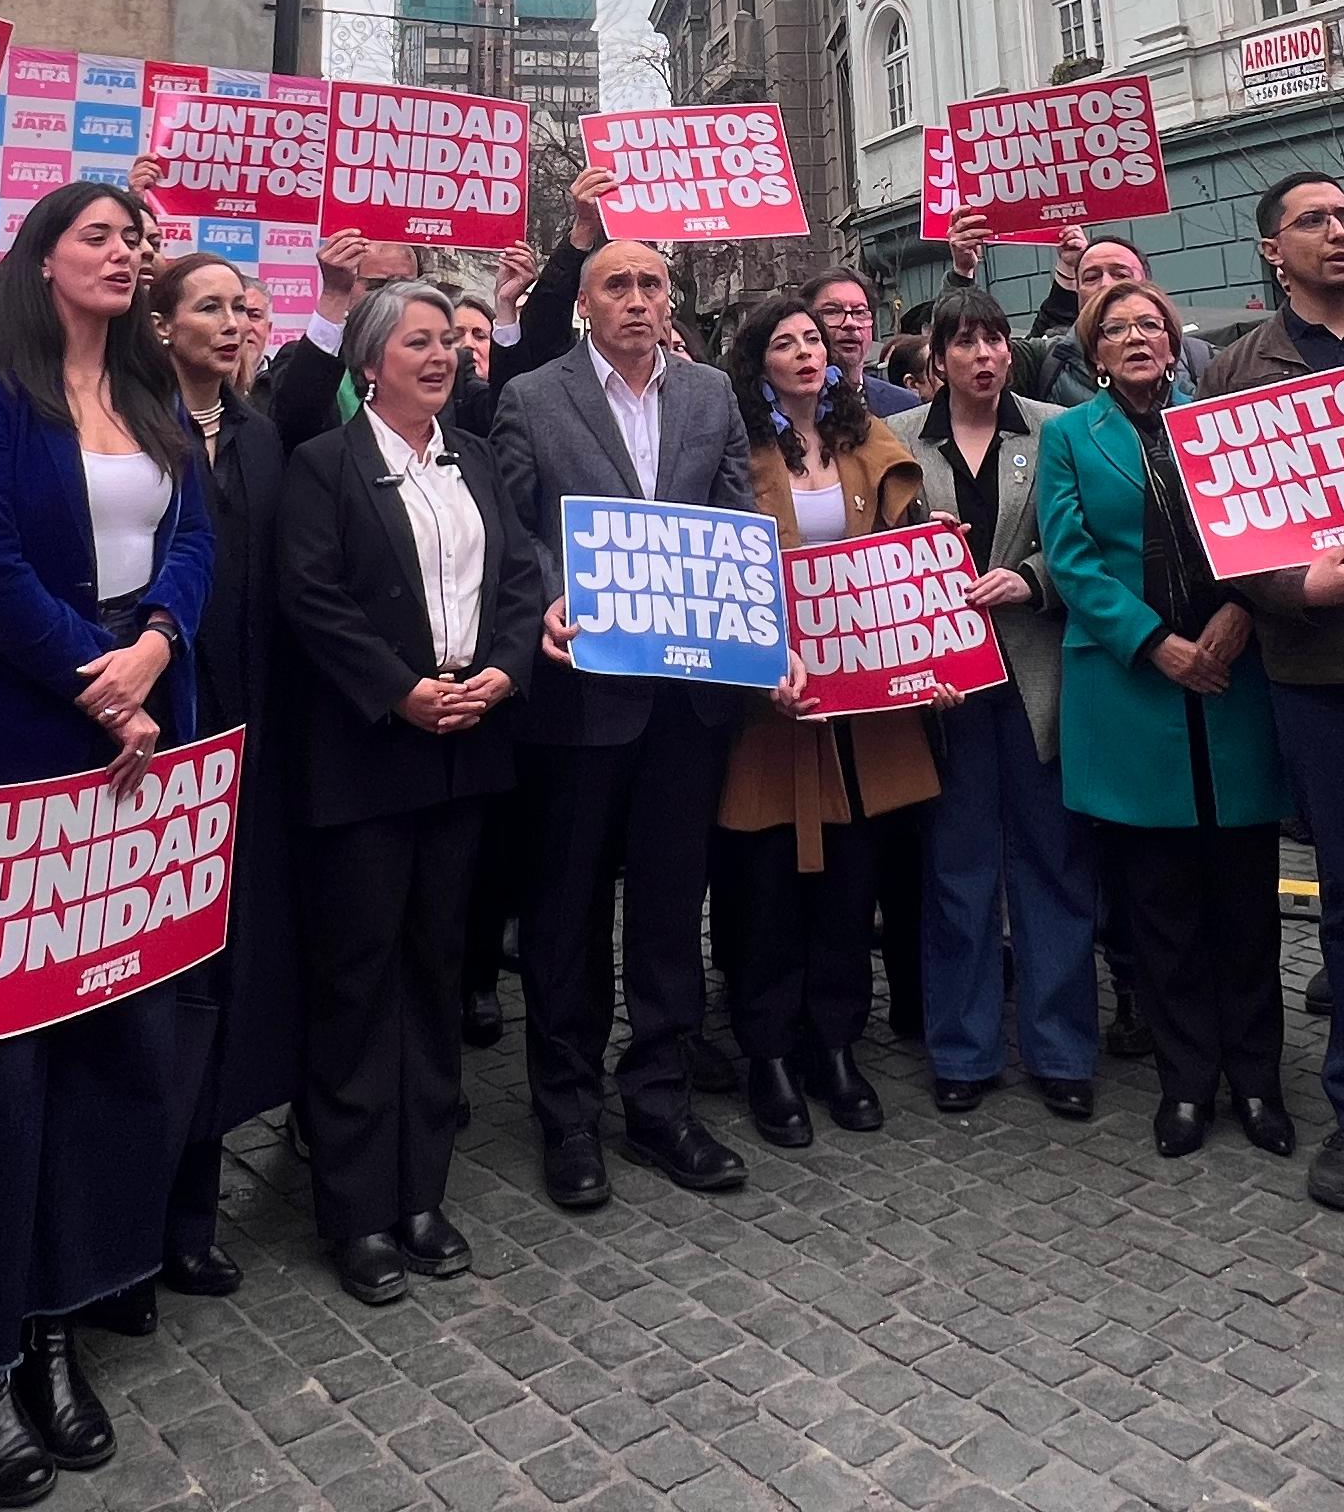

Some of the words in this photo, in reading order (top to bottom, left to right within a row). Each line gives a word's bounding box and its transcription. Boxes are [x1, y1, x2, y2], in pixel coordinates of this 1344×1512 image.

[1245, 28, 1321, 71] ARRIENDO
[15, 67, 71, 83] JARA
[84, 75, 136, 89] JARA
[12, 117, 67, 132] JARA
[80, 122, 133, 138] JARA
[159, 102, 328, 140] JUNTOS
[339, 92, 523, 143] UNIDAD
[593, 113, 777, 151] JUNTOS
[957, 86, 1145, 141] JUNTOS
[156, 131, 325, 169] JUNTOS
[336, 129, 522, 179] UNIDAD
[611, 144, 785, 183] JUNTOS
[961, 120, 1151, 174] JUNTOS
[8, 168, 63, 183] JARA
[155, 161, 323, 197] JUNTOS
[332, 167, 521, 215] UNIDAD
[606, 175, 792, 213] JUNTOS
[965, 153, 1156, 207] JUNTOS
[405, 221, 453, 236] JARA
[1040, 205, 1088, 221] JARA
[204, 231, 254, 245] JARA
[266, 234, 314, 248] JARA
[574, 511, 773, 566] JUNTAS
[575, 550, 776, 605] JUNTAS
[792, 532, 964, 597] UNIDAD
[577, 592, 780, 647] JUNTAS
[795, 570, 971, 637] UNIDAD
[663, 651, 712, 669] JARA
[799, 609, 986, 676] UNIDAD
[887, 677, 937, 697] JARA
[76, 959, 141, 996] JARA
